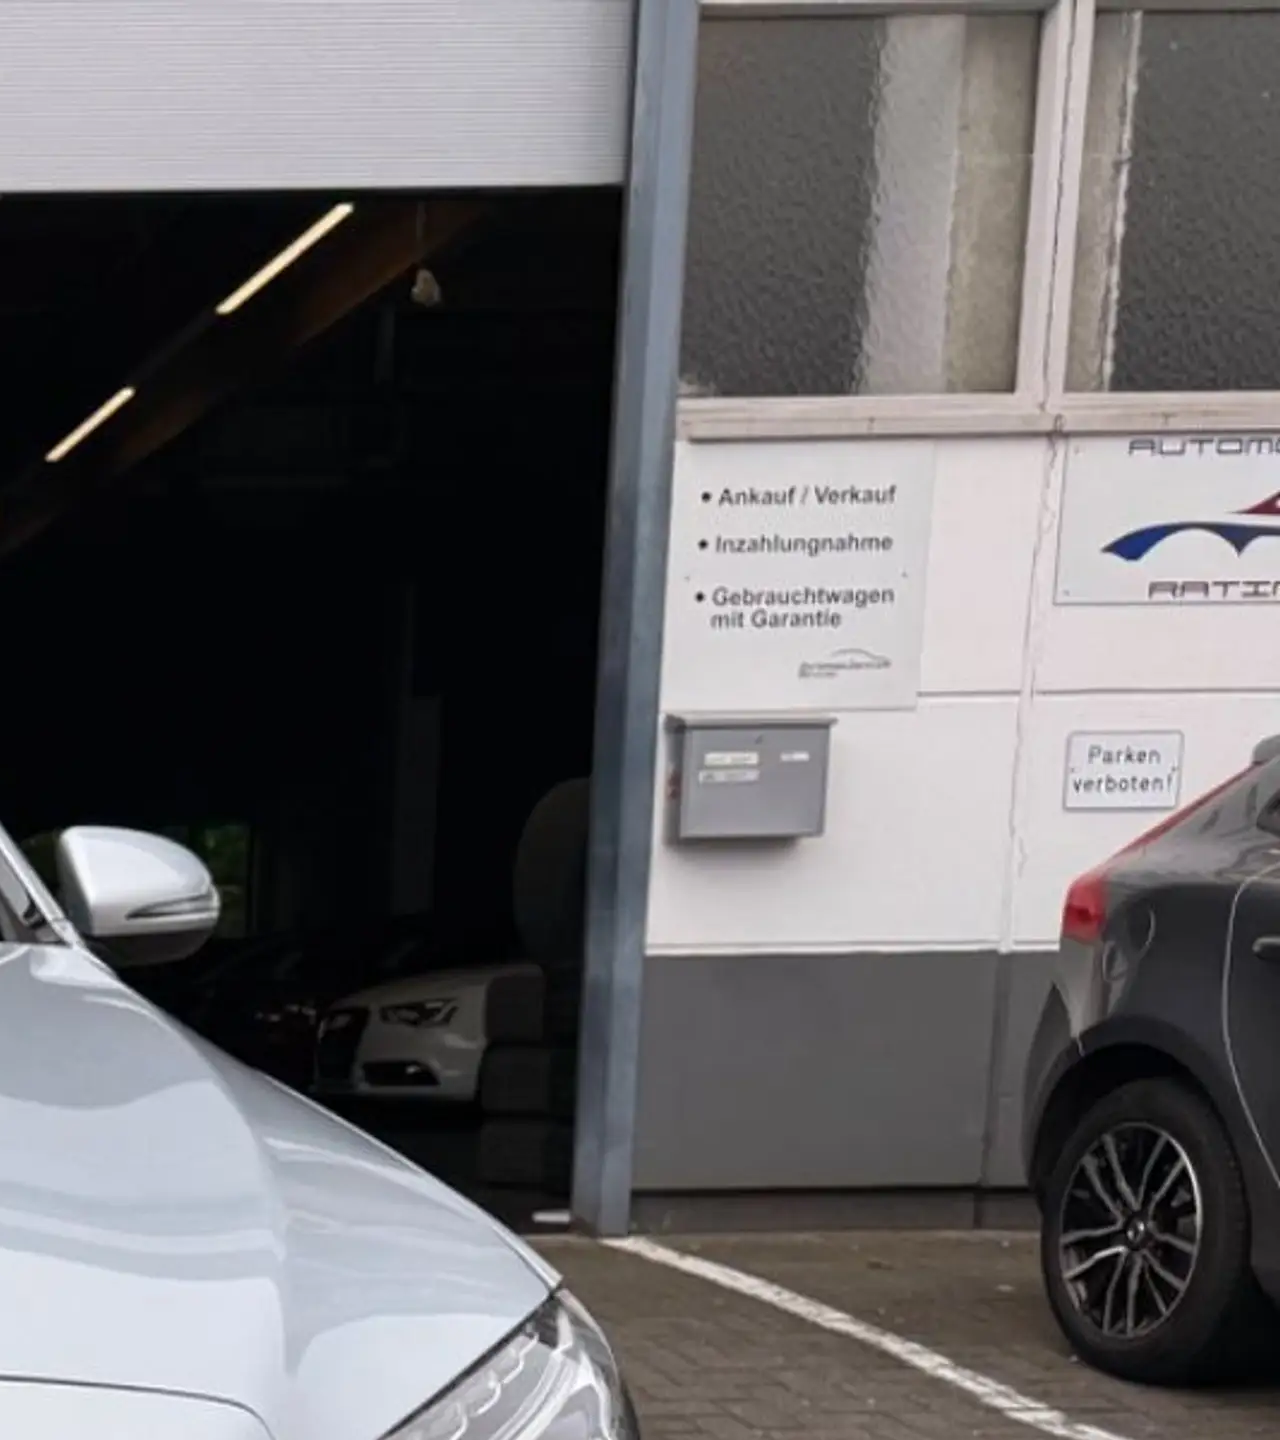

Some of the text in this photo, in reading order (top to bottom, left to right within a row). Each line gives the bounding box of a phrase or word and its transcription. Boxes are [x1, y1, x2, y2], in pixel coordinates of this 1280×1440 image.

[1129, 438, 1280, 455] AUTOM
[718, 485, 897, 506] Ankauf / Verkauf
[715, 533, 893, 557] Inzahlungnahme
[712, 585, 895, 607] Gebrauchtwagen
[711, 609, 842, 628] mit Garantie
[1088, 744, 1161, 765] Parken
[1073, 773, 1172, 793] verboten!
